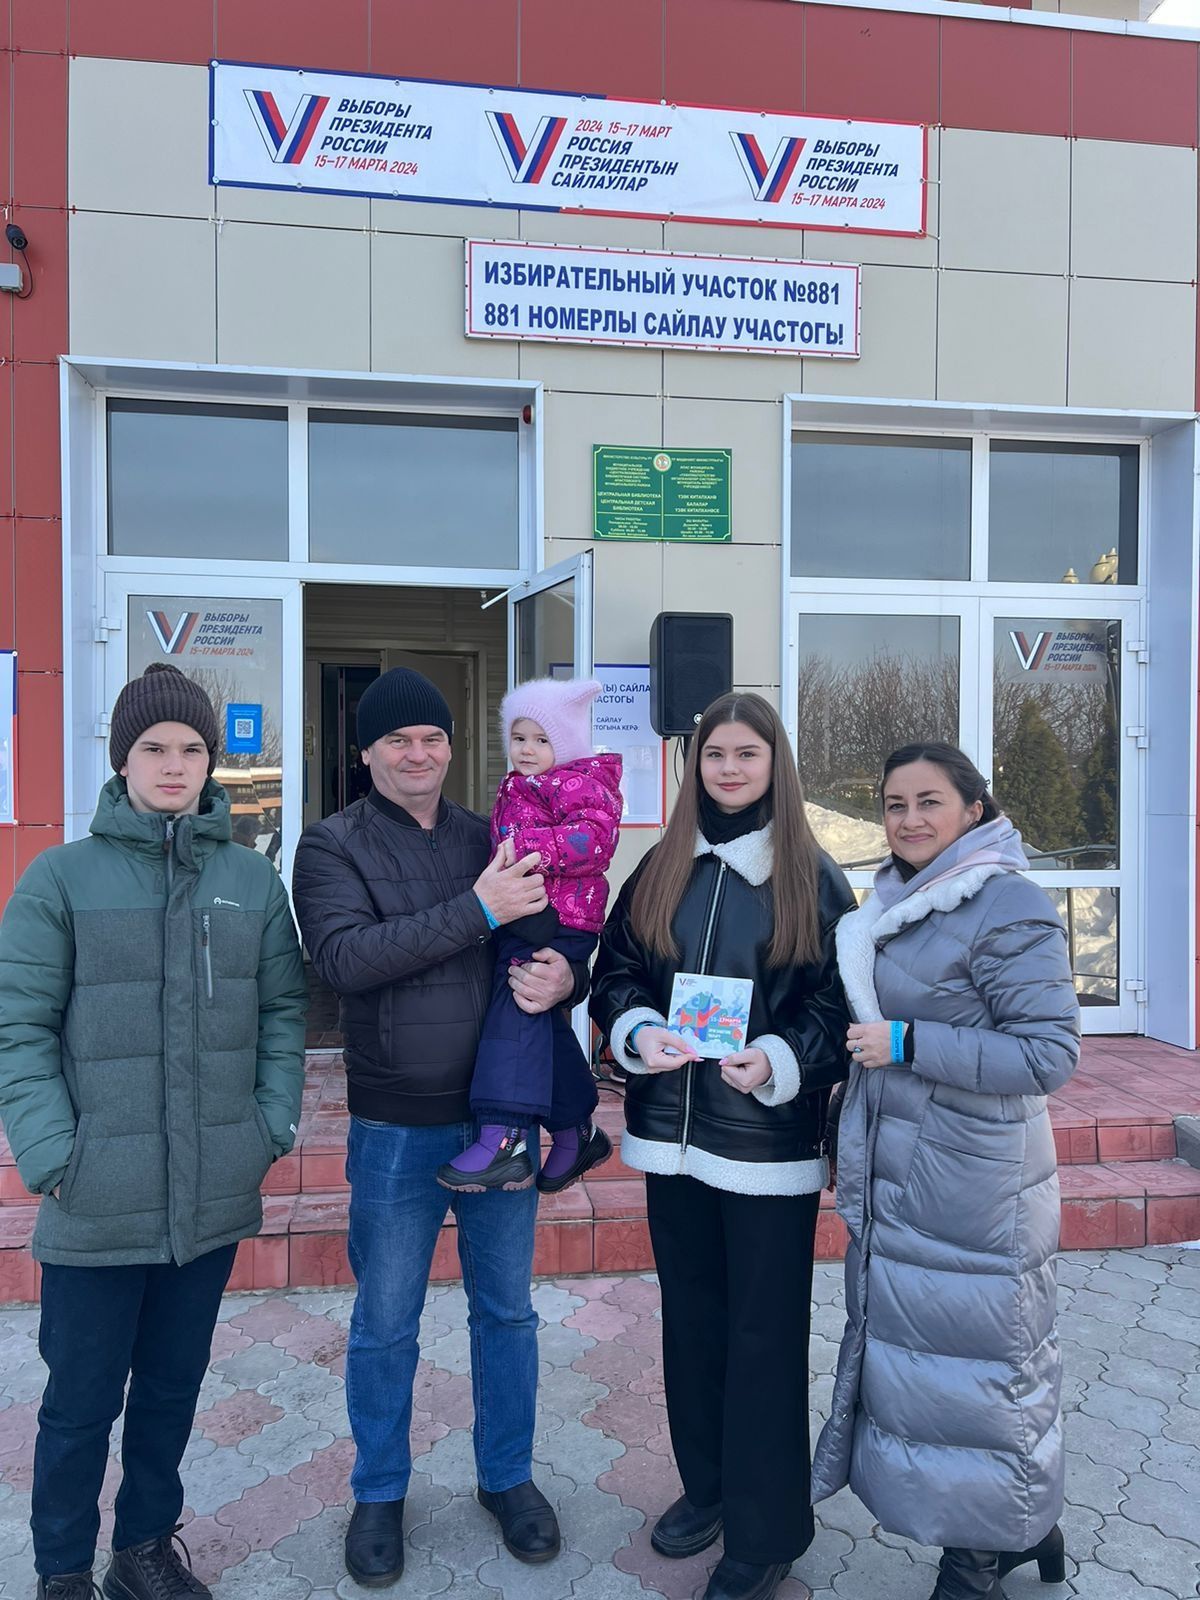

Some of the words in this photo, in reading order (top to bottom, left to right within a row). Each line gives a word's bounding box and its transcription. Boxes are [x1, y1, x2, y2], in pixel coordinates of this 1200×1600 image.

[337, 98, 412, 118] ВЫБОРЫ
[329, 116, 434, 140] ПРЕЗИДЕНТА
[575, 119, 603, 133] 2024
[639, 124, 673, 139] МАРТ
[320, 135, 389, 155] РОССИИ
[566, 136, 633, 155] РОССИЯ
[813, 139, 881, 157] ВЫБОРЫ
[347, 156, 389, 173] МАРТА
[390, 160, 418, 176] 2024
[558, 153, 679, 176] ПРЕЗИДЕНТЫН
[805, 157, 900, 177] ПРЕЗИДЕНТА
[551, 171, 649, 192] САЙЛАУЛАР
[798, 175, 860, 193] РОССИИ
[822, 194, 859, 209] МАРТА
[860, 196, 886, 210] 2024
[484, 261, 676, 295] ИЗБИРАТЕЛЬНЫЙ
[682, 272, 777, 302] УЧАСТОК
[783, 279, 840, 305] №881
[484, 302, 520, 327] 881
[528, 304, 637, 334] НОМЕРЛЫ
[643, 308, 727, 339] САЙЛАУ
[204, 612, 250, 623] ВЫБОРЫ
[198, 624, 263, 635] ПРЕЗИДЕНТА
[1056, 632, 1094, 641] ВЫБОРЫ
[193, 636, 235, 646] РОССИИ
[211, 647, 236, 656] МАРТА
[236, 647, 254, 657] 2024
[1047, 653, 1082, 662] РОССИИ
[619, 683, 651, 693] САЙЛА
[594, 695, 635, 704] АСТОГЫ
